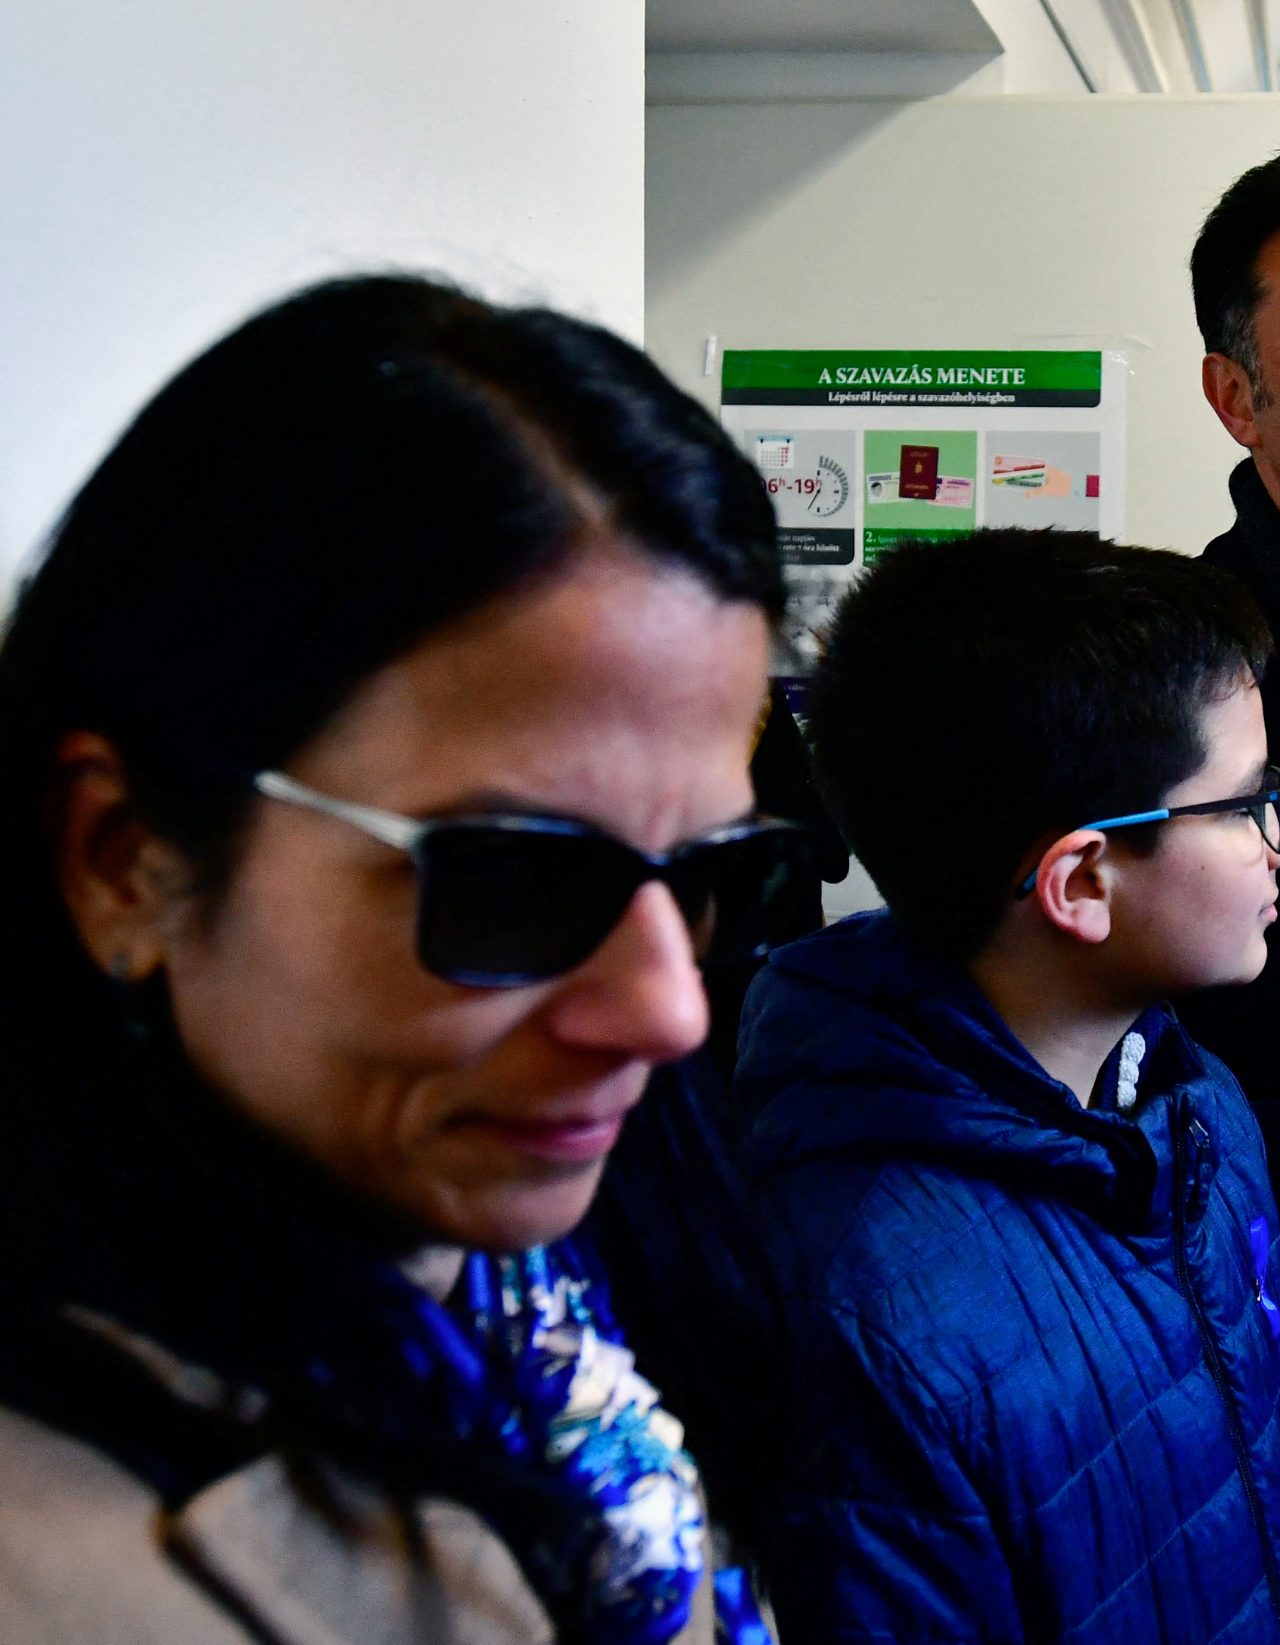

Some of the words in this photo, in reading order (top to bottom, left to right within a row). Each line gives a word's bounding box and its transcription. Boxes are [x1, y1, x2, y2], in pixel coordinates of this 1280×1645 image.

[818, 367, 832, 384] A
[836, 363, 933, 385] SZAVAZÁS
[936, 367, 1025, 385] MENETE
[872, 391, 908, 404] lépésre
[909, 394, 917, 402] a
